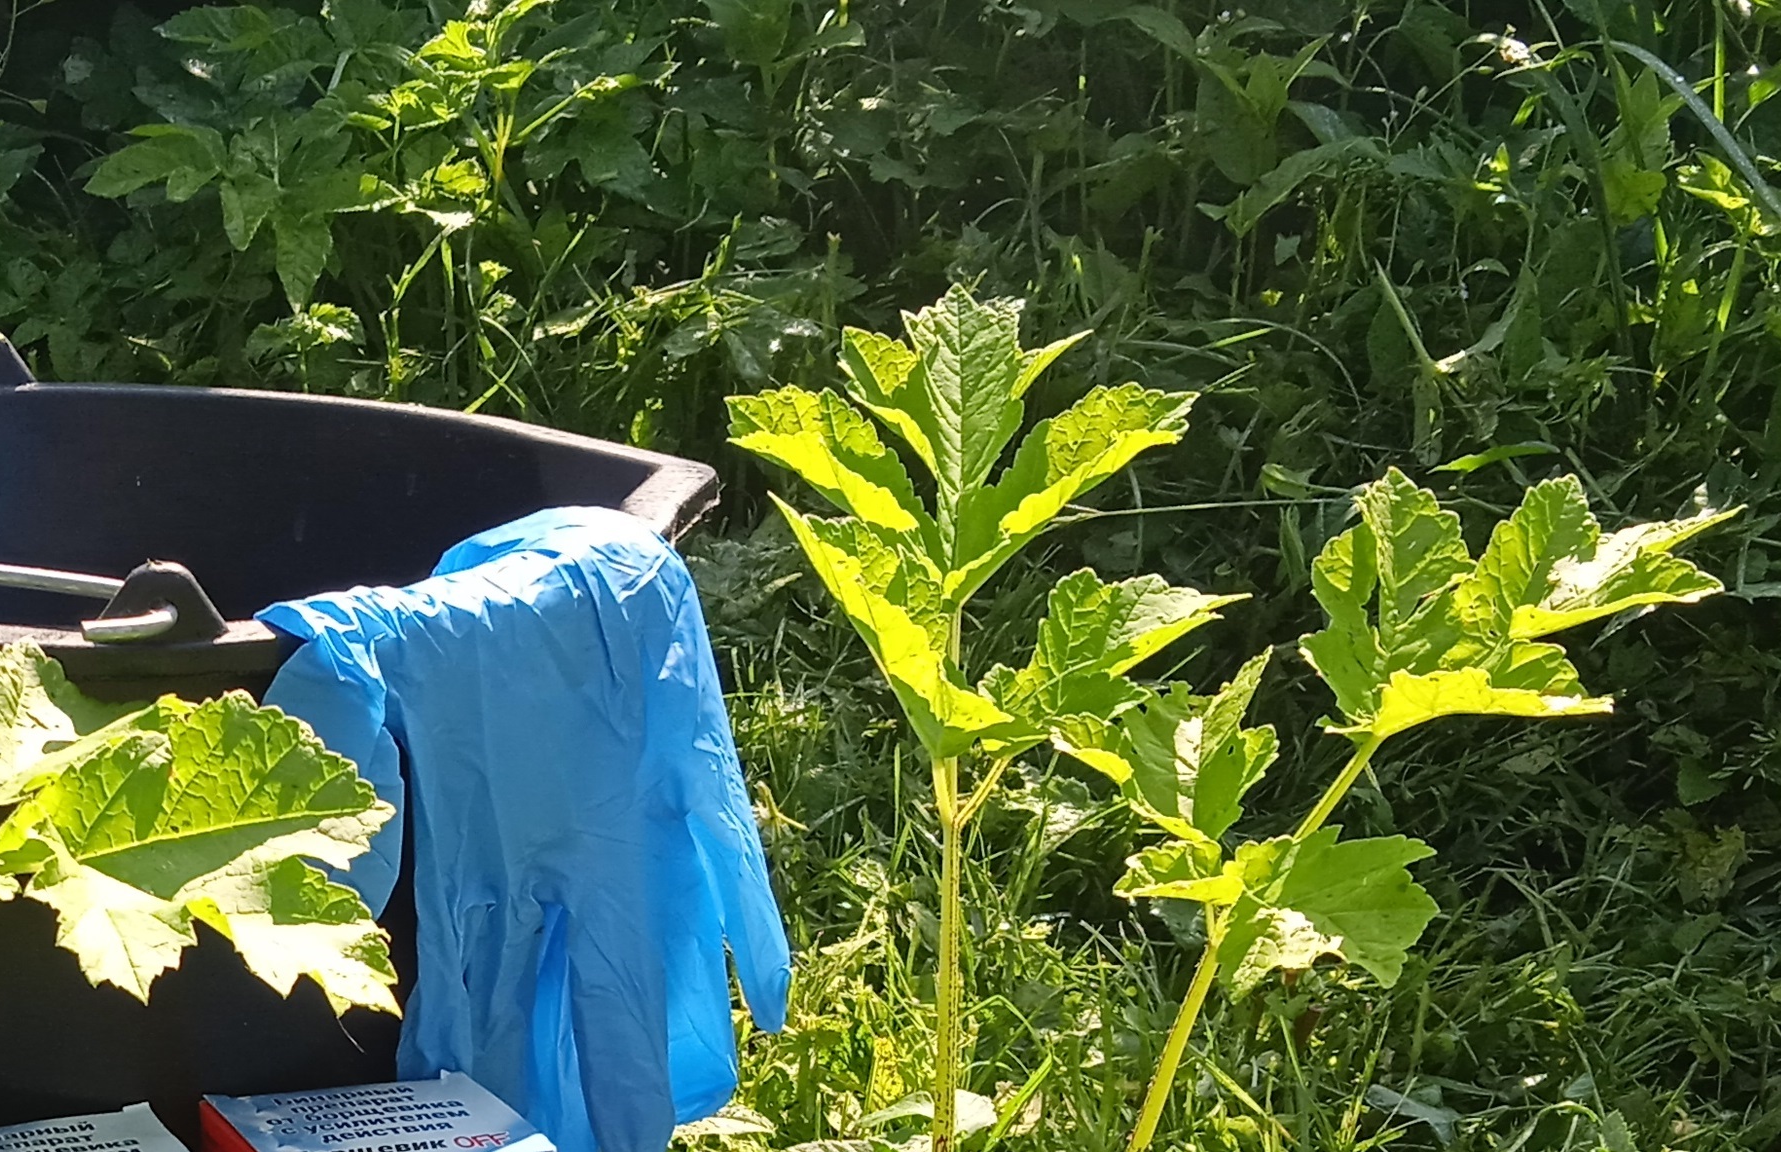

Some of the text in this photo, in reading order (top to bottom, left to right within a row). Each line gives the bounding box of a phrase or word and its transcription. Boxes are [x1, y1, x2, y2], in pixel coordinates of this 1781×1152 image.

[266, 1098, 465, 1127] от борщевика
[291, 1096, 415, 1115] препарат
[281, 1108, 470, 1136] с усилителем
[322, 1121, 454, 1144] действия
[453, 1132, 511, 1148] OFF
